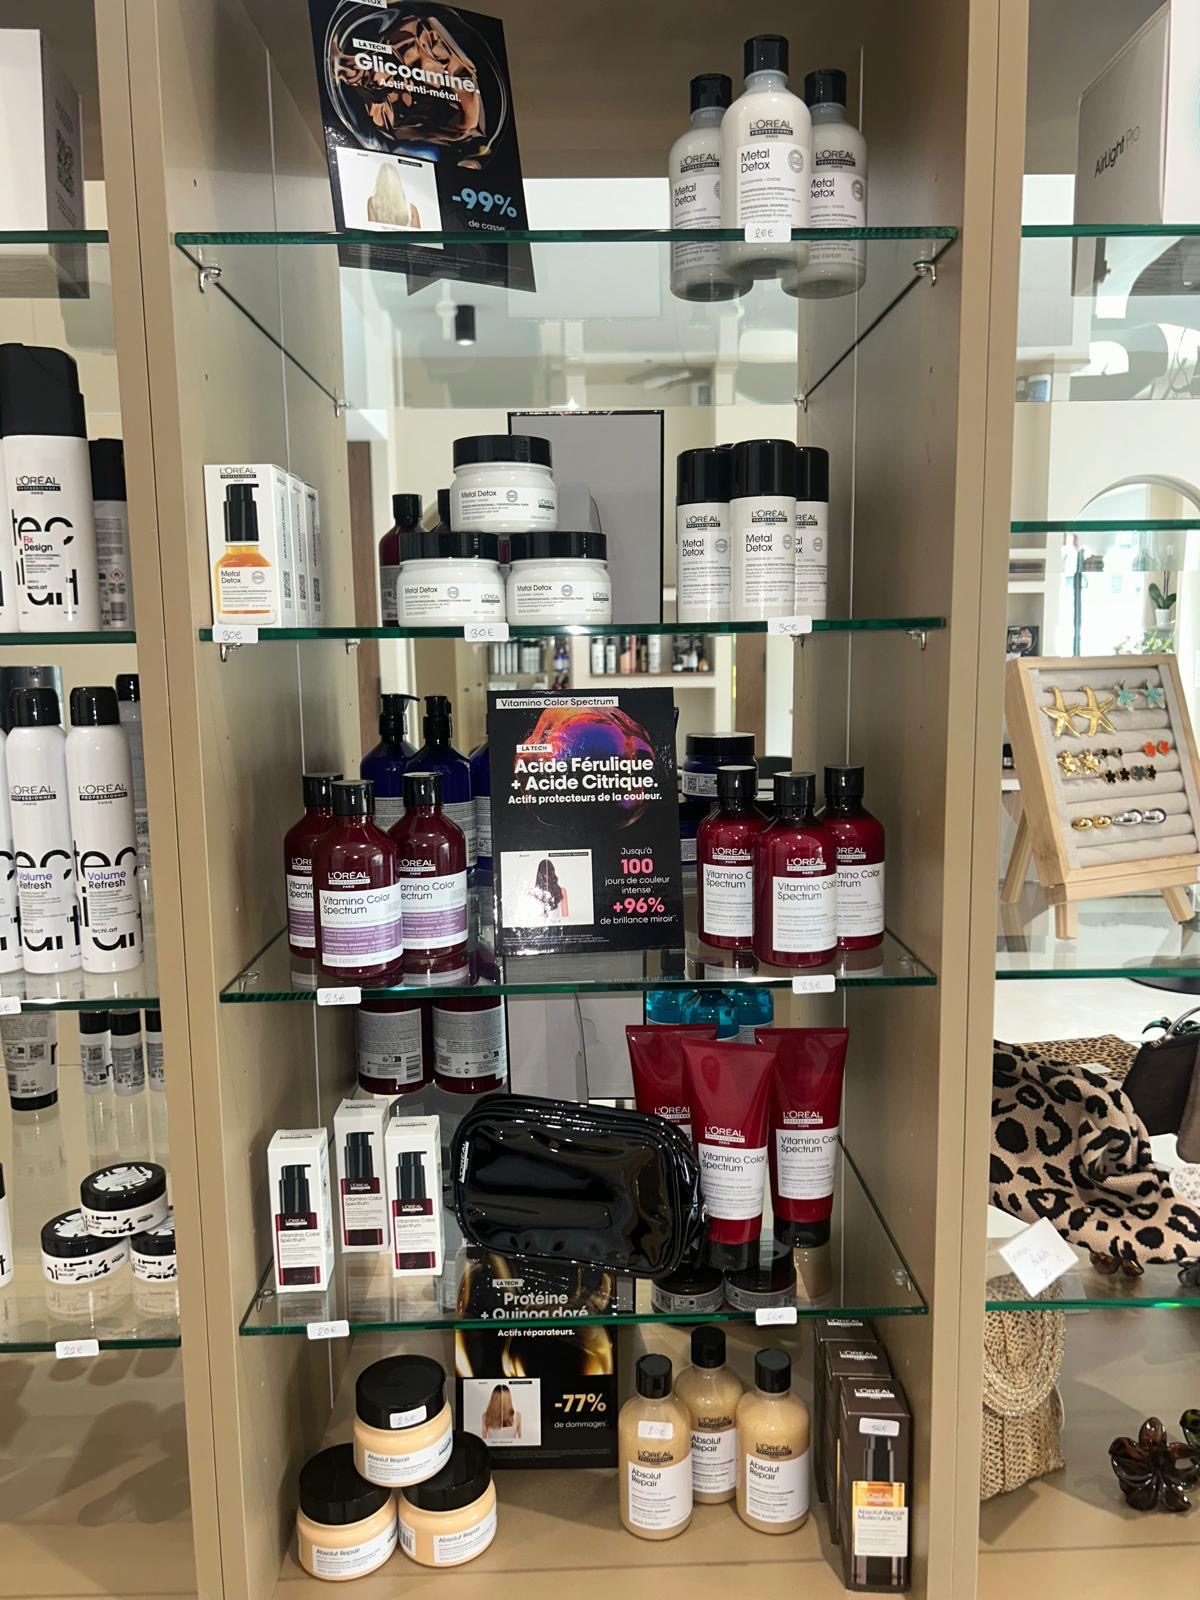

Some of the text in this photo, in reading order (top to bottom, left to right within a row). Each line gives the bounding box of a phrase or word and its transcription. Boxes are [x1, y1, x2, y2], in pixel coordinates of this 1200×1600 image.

[369, 43, 387, 52] TECH
[354, 52, 480, 95] Glicoamine.
[380, 78, 461, 102] Actif anti-métal.
[750, 119, 793, 130] L'ORÉAL
[680, 153, 720, 168] L'ORÉAL
[741, 149, 770, 163] Metal
[816, 150, 856, 161] L'ORÉAL
[741, 161, 770, 174] Detox
[674, 182, 696, 198] Metal
[452, 187, 518, 218] -99%
[675, 194, 697, 208] Detox
[468, 218, 480, 229] de
[220, 466, 257, 475] L'ORÉAL
[16, 476, 61, 486] L'ORÉAL
[752, 510, 787, 518] L'ORÉAL
[682, 538, 704, 548] Metal
[746, 534, 773, 543] Metal
[24, 543, 53, 553] Design
[682, 548, 705, 557] Detox
[746, 544, 773, 553] Detox
[222, 630, 243, 641] 30€
[470, 628, 494, 638] 30€
[501, 697, 614, 708] Vitamino Color Spectrum
[514, 757, 654, 776] Acide Férulique
[511, 774, 659, 792] + Acide Citrique.
[11, 785, 56, 794] ORÉAL
[78, 784, 128, 795] L'ORÉAL
[508, 792, 662, 805] Actifs protecteurs de la couleur.
[621, 847, 652, 856] Jusqu'à
[712, 847, 751, 856] L'ORÉAL
[621, 858, 654, 875] 100
[786, 857, 826, 866] L'ORÉAL
[88, 870, 126, 881] Volume
[328, 871, 371, 880] L'ORÉAL
[706, 870, 744, 880] Vitamino
[861, 870, 880, 879] Color
[89, 879, 126, 889] Refresh
[400, 881, 455, 892] amino Color
[605, 876, 670, 887] jours de couleur
[706, 878, 746, 889] Spectrum
[778, 882, 820, 892] Vitamino
[322, 894, 390, 906] Vitamino Color
[777, 891, 822, 901] Spectrum
[323, 905, 367, 916] Spectrum
[613, 897, 665, 914] +96%
[613, 916, 648, 924] brillance
[783, 1111, 823, 1119] L'ORÉAL
[704, 1126, 745, 1138] L'ORÉAL
[781, 1136, 821, 1145] Vitamino
[781, 1144, 823, 1154] Spectrum
[702, 1151, 765, 1164] Vitamino Color
[702, 1160, 744, 1173] Spectrum
[504, 1291, 568, 1306] Protéine
[481, 1312, 489, 1320] +
[498, 1328, 575, 1338] Actifs réparateurs.
[554, 1394, 607, 1413] -77%
[554, 1421, 564, 1429] de
[692, 1434, 721, 1445] Absolut
[692, 1442, 717, 1452] Repair
[750, 1460, 780, 1473] Absolut
[632, 1468, 662, 1479] Absolut
[750, 1467, 776, 1480] Repair
[632, 1474, 657, 1487] Repair
